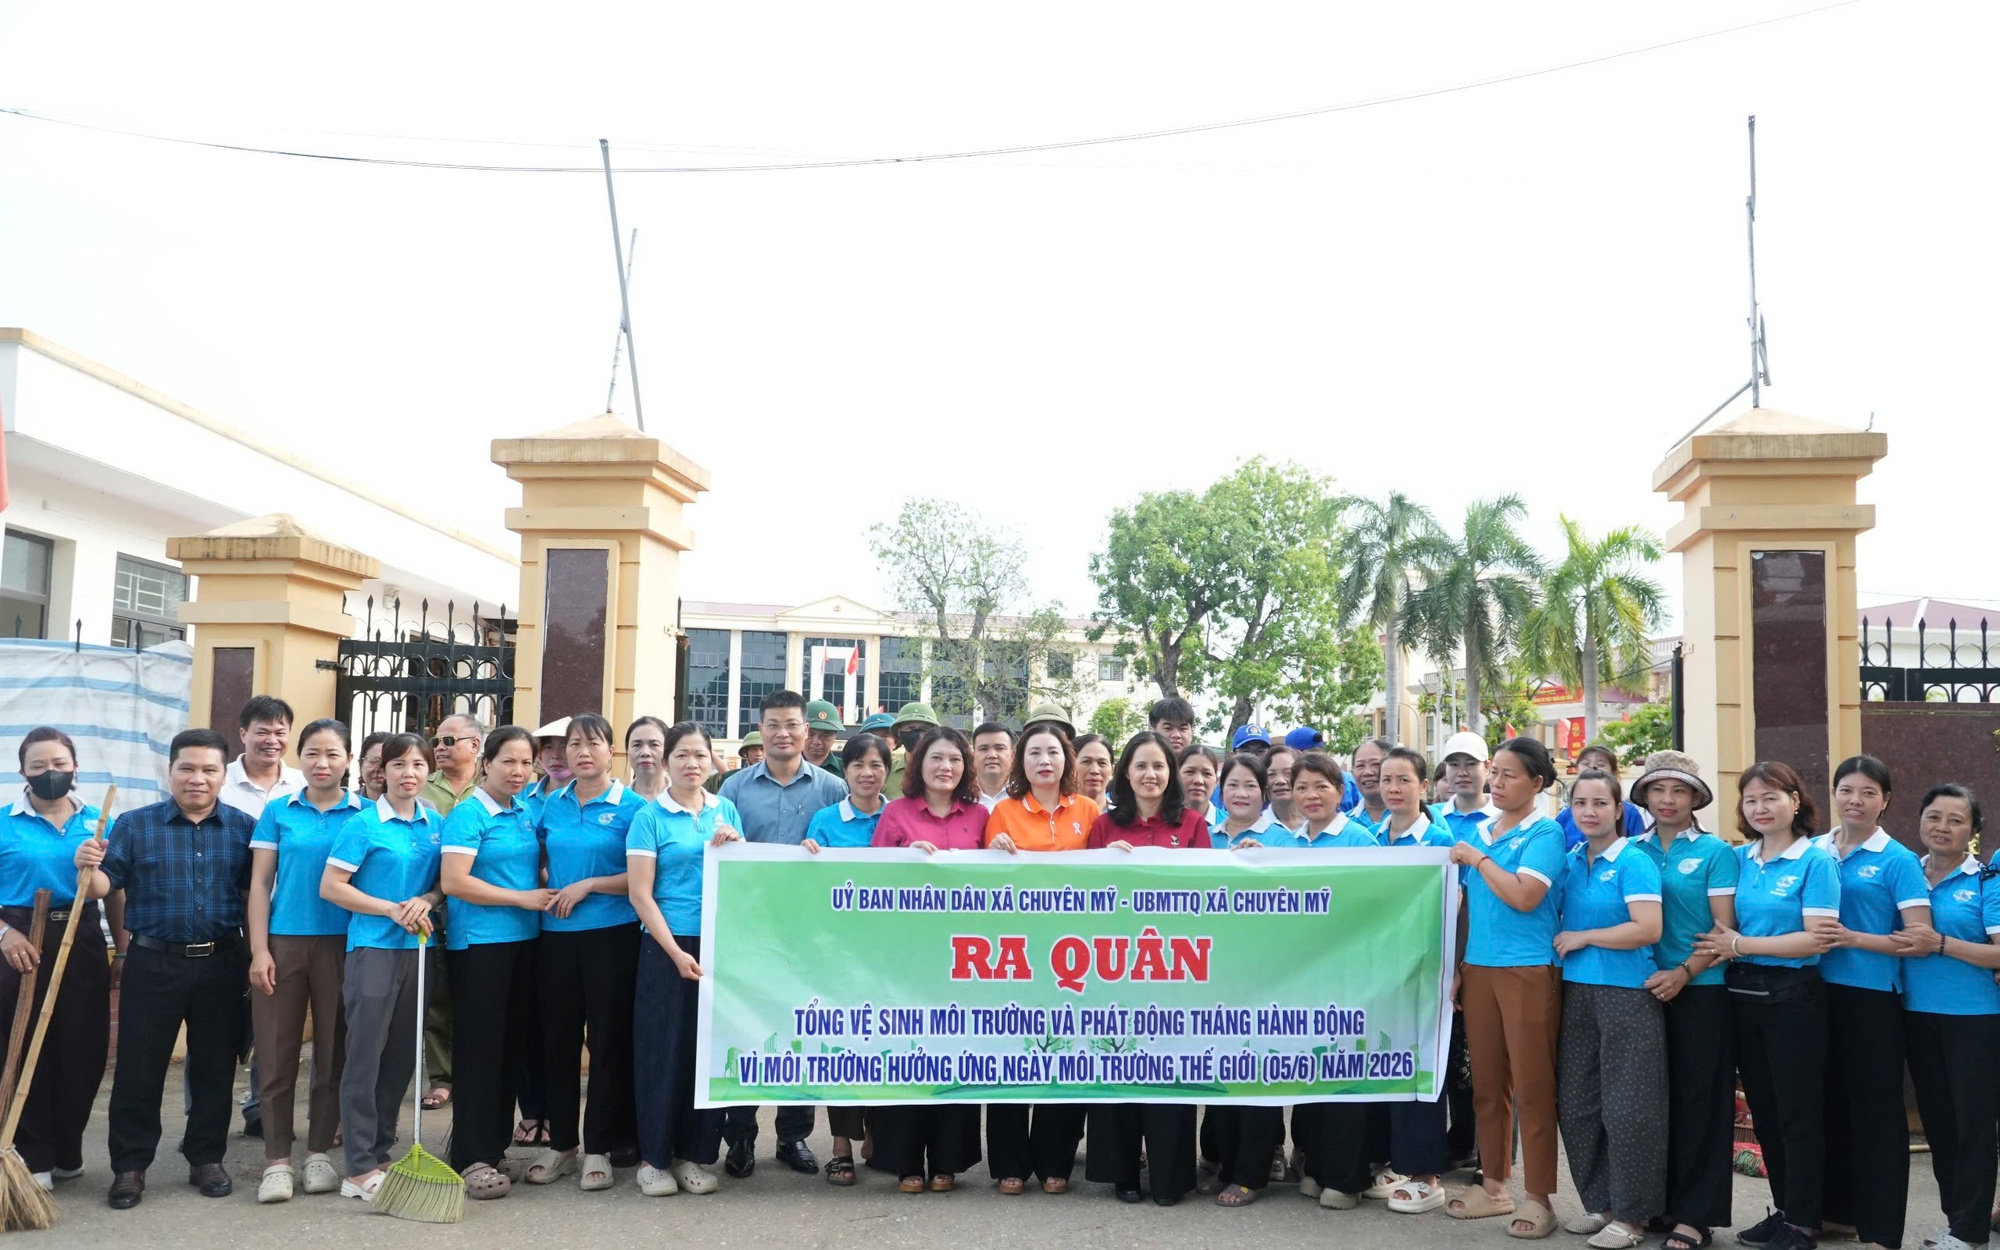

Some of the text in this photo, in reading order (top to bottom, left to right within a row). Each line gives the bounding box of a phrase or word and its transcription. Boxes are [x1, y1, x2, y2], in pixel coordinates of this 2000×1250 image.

[833, 881, 854, 909] UỶ
[860, 889, 894, 910] BAN
[900, 885, 946, 910] NHÂN
[951, 886, 986, 911] DÂN
[991, 886, 1014, 911] XÃ
[1019, 886, 1085, 912] CHUYÊN
[1090, 887, 1117, 912] MỸ
[1133, 891, 1201, 915] UBMTTQ
[1206, 888, 1228, 912] XÃ
[1233, 887, 1299, 913] CHUYÊN
[1304, 888, 1330, 913] MỸ
[952, 928, 1211, 992] RA QUÂN
[794, 998, 1365, 1042] TỔNG VỆ SINH MÔI TRƯỜNG VÀ PHÁT ĐỘNG THÁNG HÀNH ĐỘNG
[740, 1046, 1413, 1084] VÌ MÔI TRƯỜNG HƯỞNG ỨNG NGÀY MÔI TRƯỜNG THẾ GIỚI (05/6) NĂM 2026
